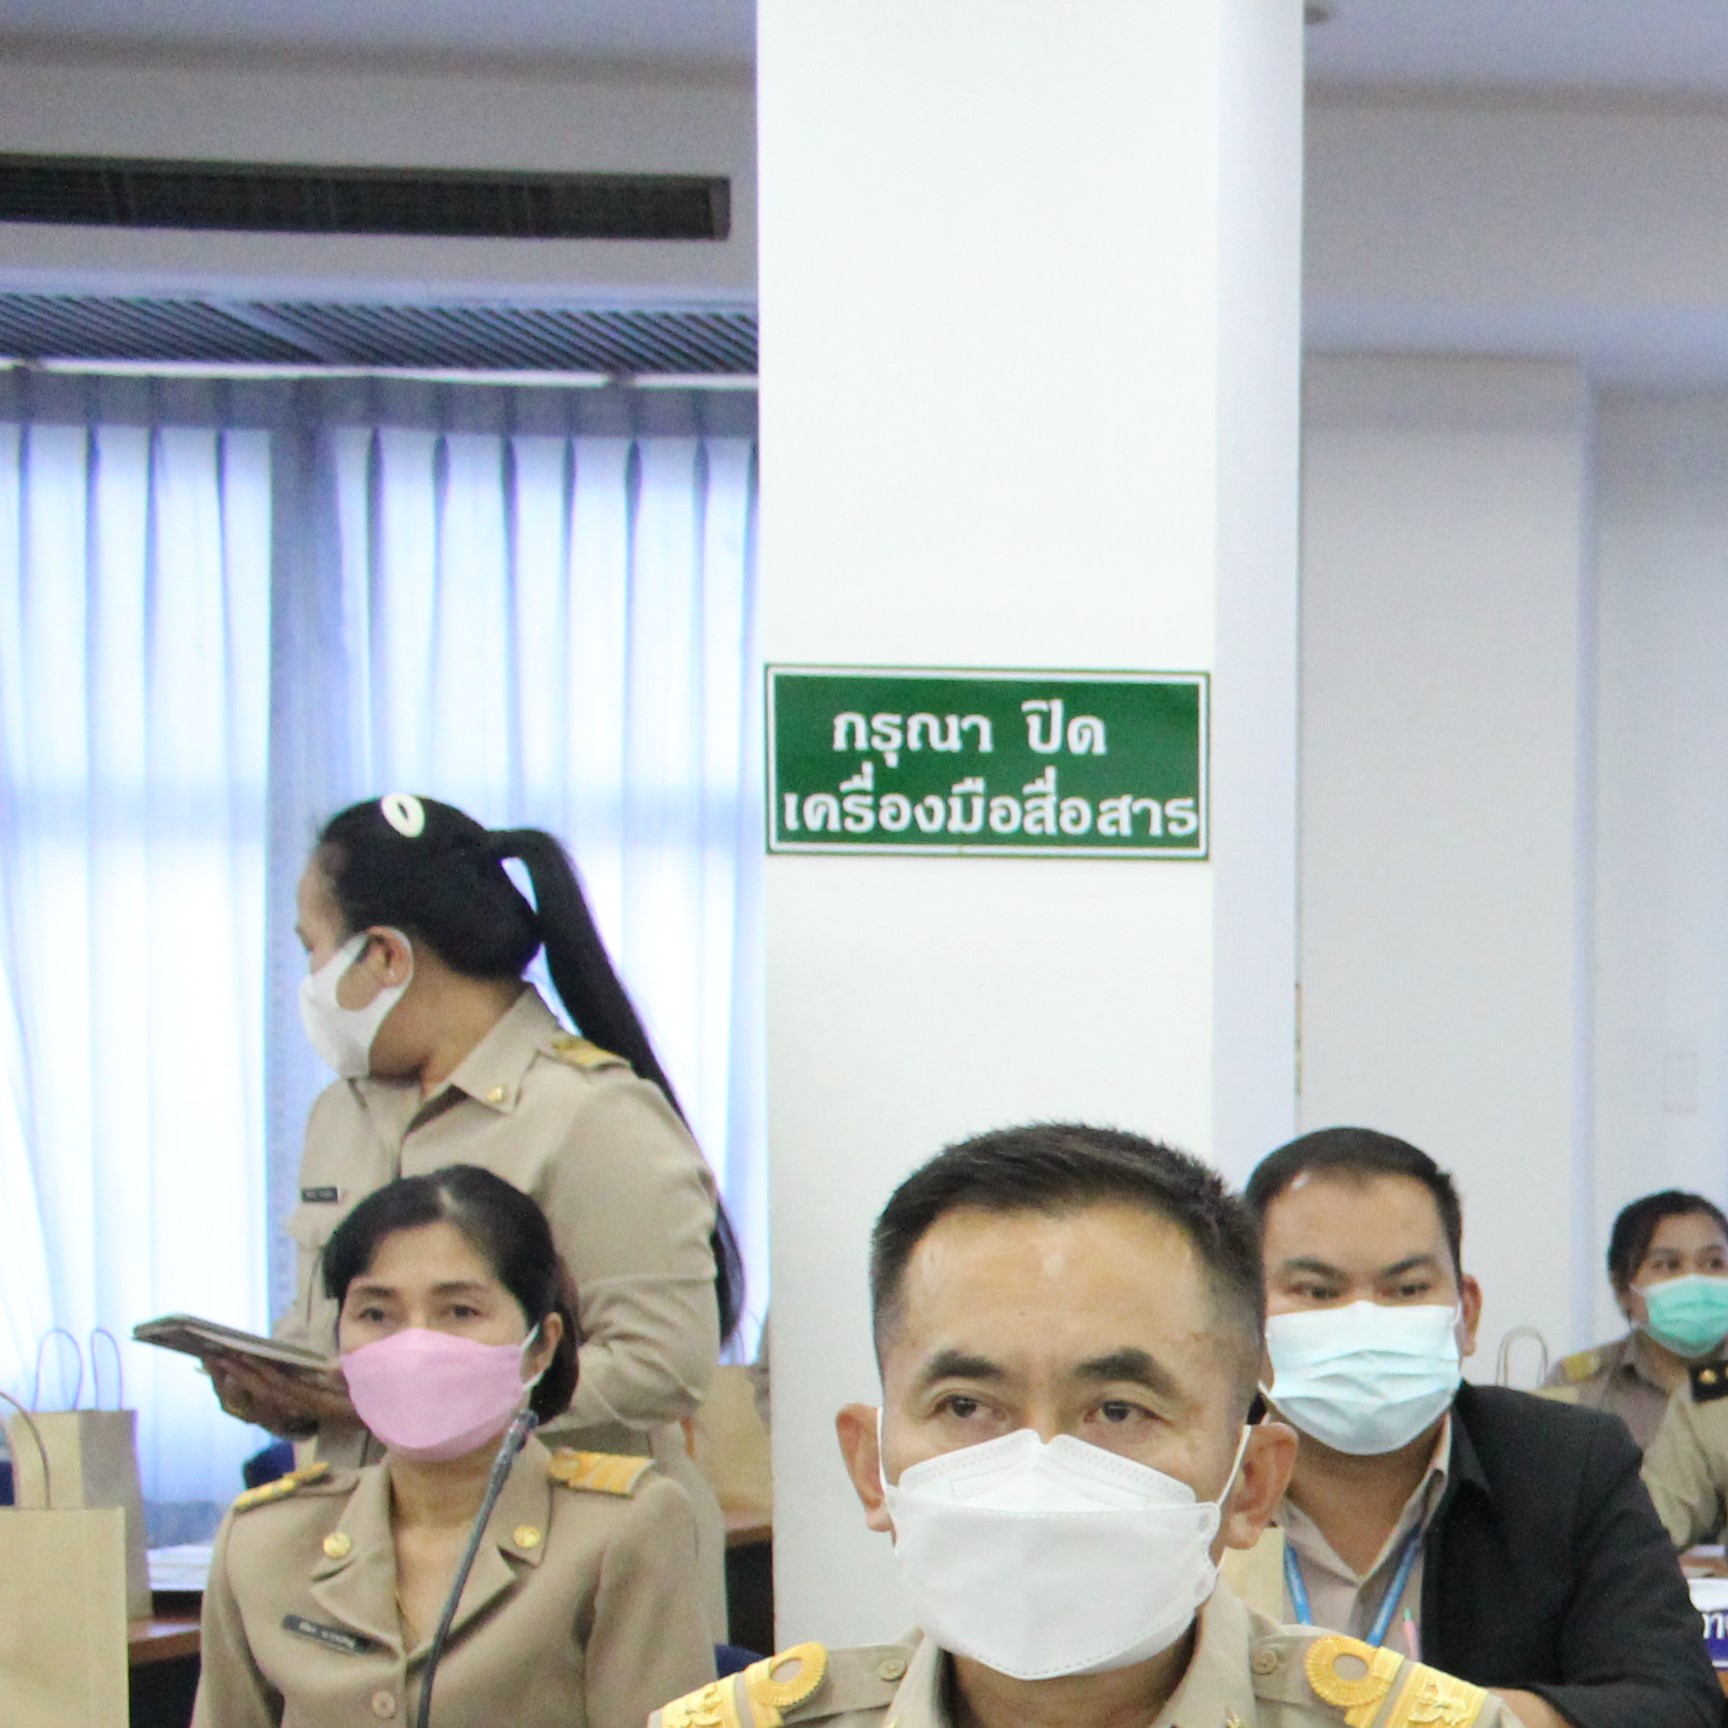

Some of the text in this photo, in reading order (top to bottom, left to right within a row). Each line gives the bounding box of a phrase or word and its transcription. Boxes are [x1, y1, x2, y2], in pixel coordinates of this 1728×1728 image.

[832, 699, 1106, 769] กรุณา ปิด
[783, 762, 1199, 837] เครื่องมือสื่อสาร
